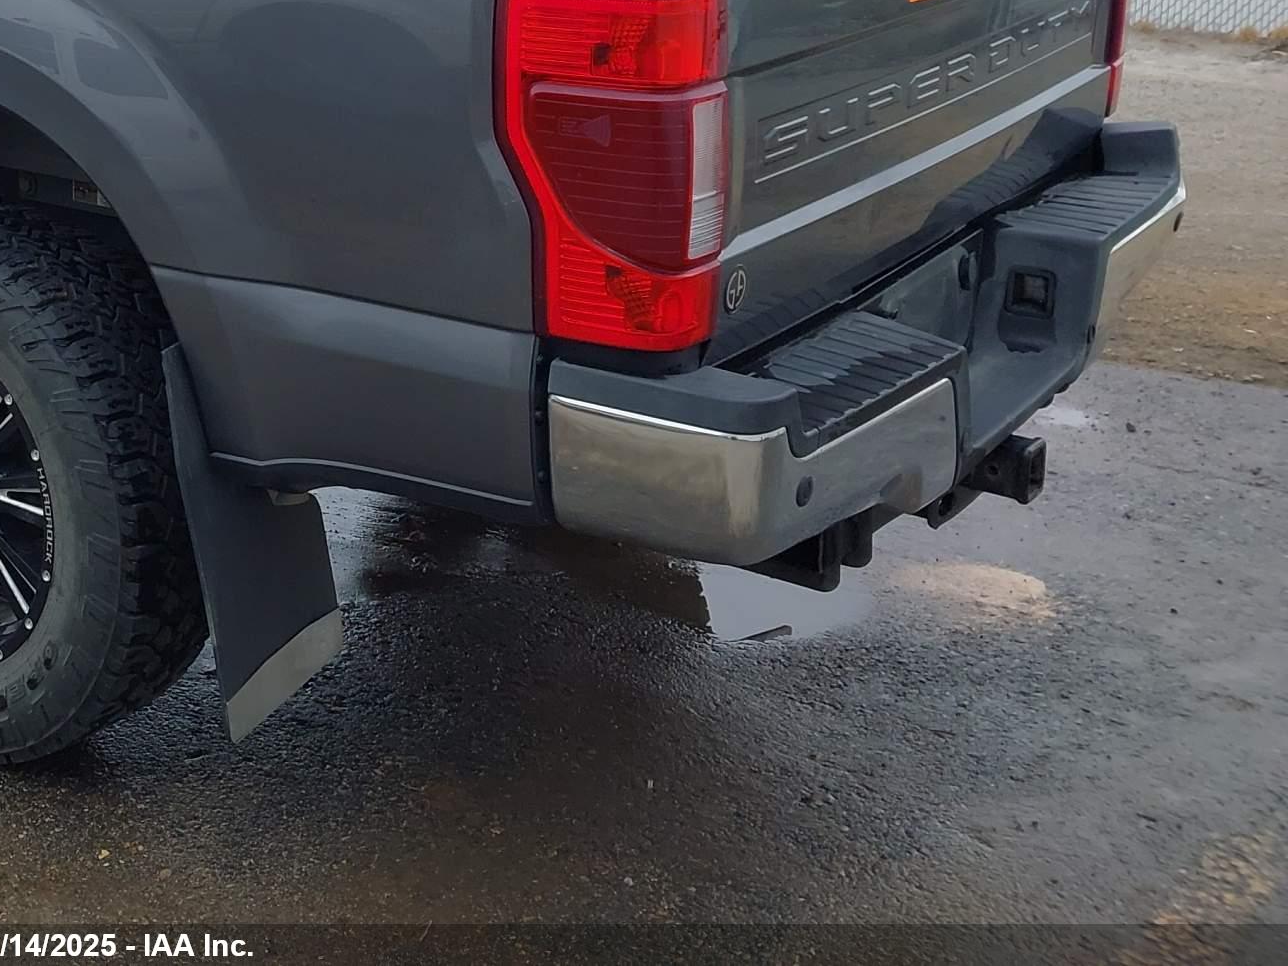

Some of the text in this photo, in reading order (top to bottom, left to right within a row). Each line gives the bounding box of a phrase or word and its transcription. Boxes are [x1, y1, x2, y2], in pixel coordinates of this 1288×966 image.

[763, 0, 1091, 166] SUPER DUTY
[36, 467, 54, 565] HARDROCK
